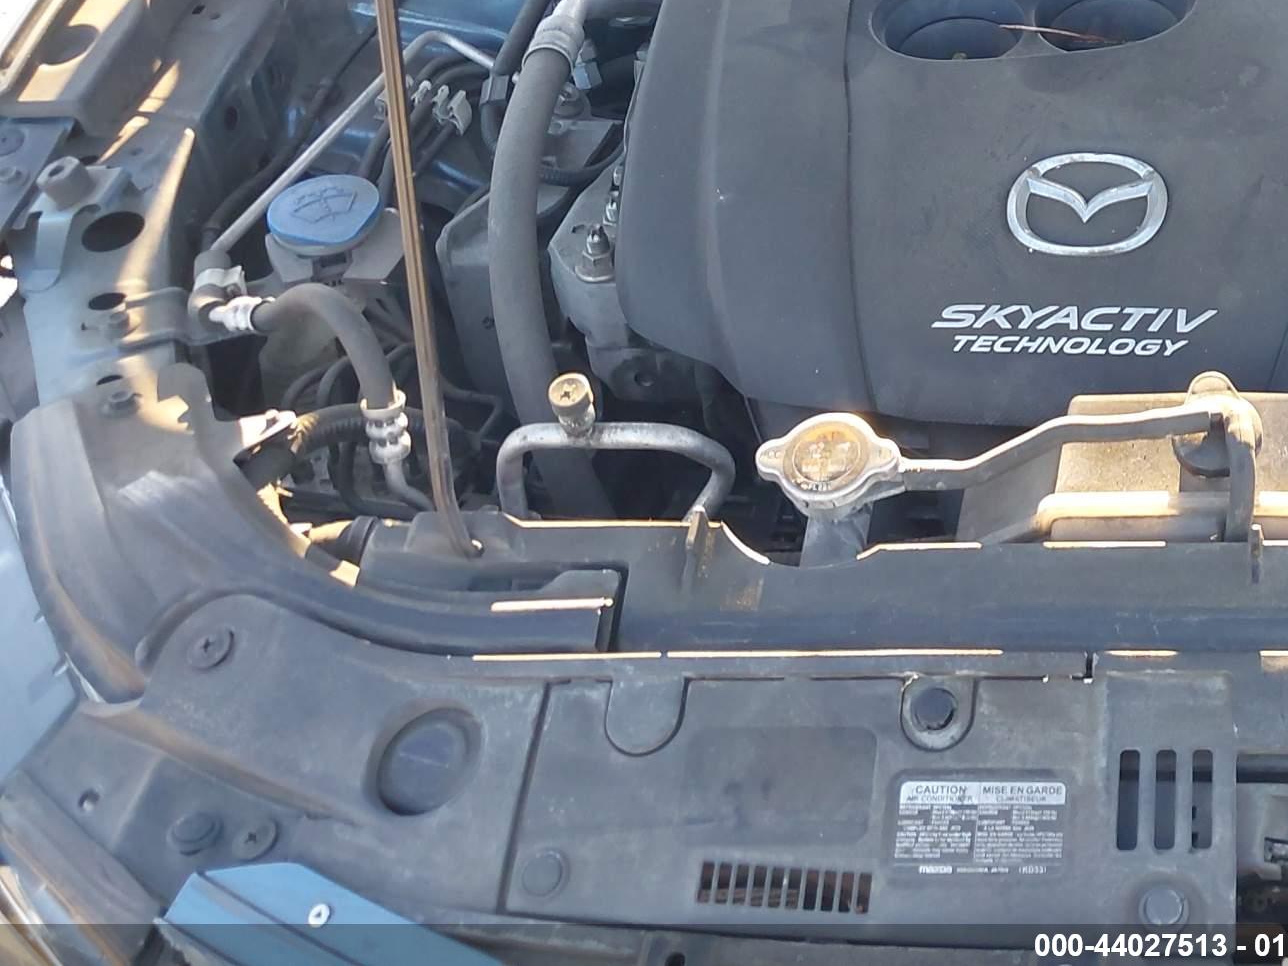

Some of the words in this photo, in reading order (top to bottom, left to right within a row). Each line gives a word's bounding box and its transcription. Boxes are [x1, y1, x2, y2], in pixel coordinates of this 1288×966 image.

[932, 305, 1217, 332] SKYACTIV
[954, 335, 1188, 355] TECHNOLOGY
[915, 785, 967, 794] CAUTION
[982, 786, 1007, 794] MISE
[1010, 786, 1024, 794] EN
[1026, 786, 1062, 794] GARDE
